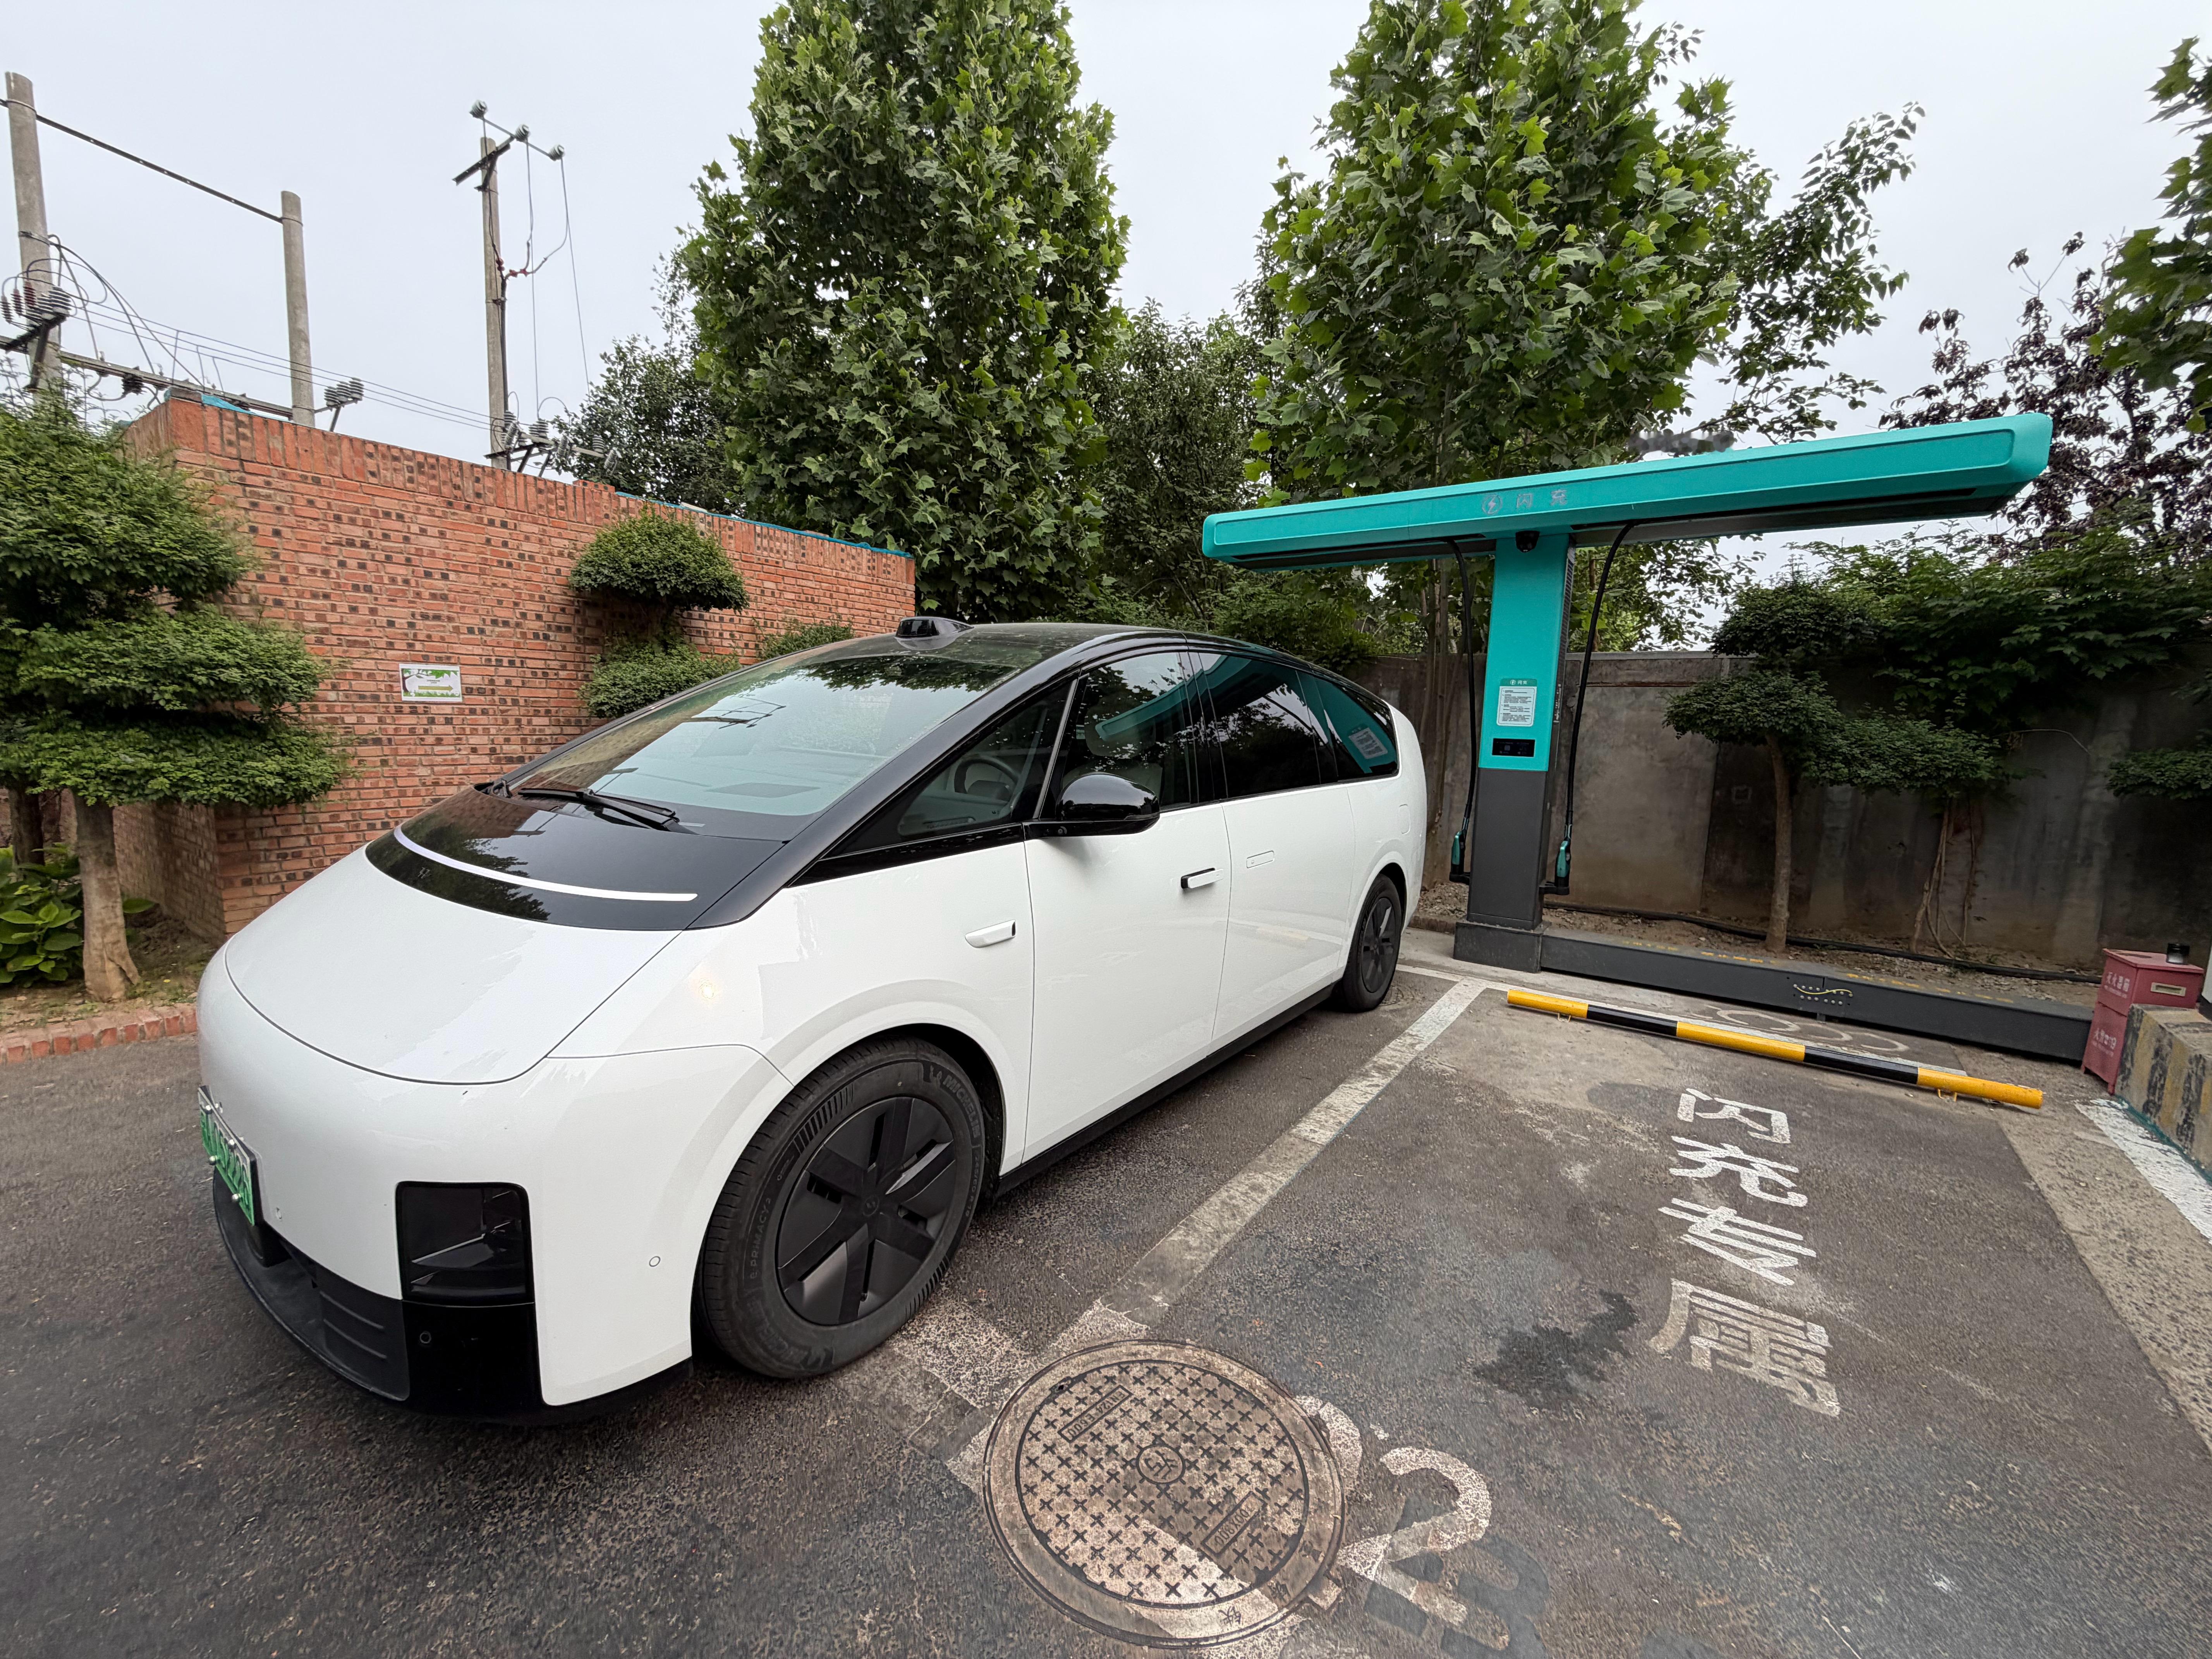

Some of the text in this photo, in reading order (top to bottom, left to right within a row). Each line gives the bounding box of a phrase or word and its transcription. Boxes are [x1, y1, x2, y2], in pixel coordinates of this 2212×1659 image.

[1516, 489, 1568, 509] 闪充
[942, 1075, 979, 1139] MICHELIN
[1648, 1087, 1841, 1417] 闪充专属
[1095, 1389, 1126, 1415] EN124
